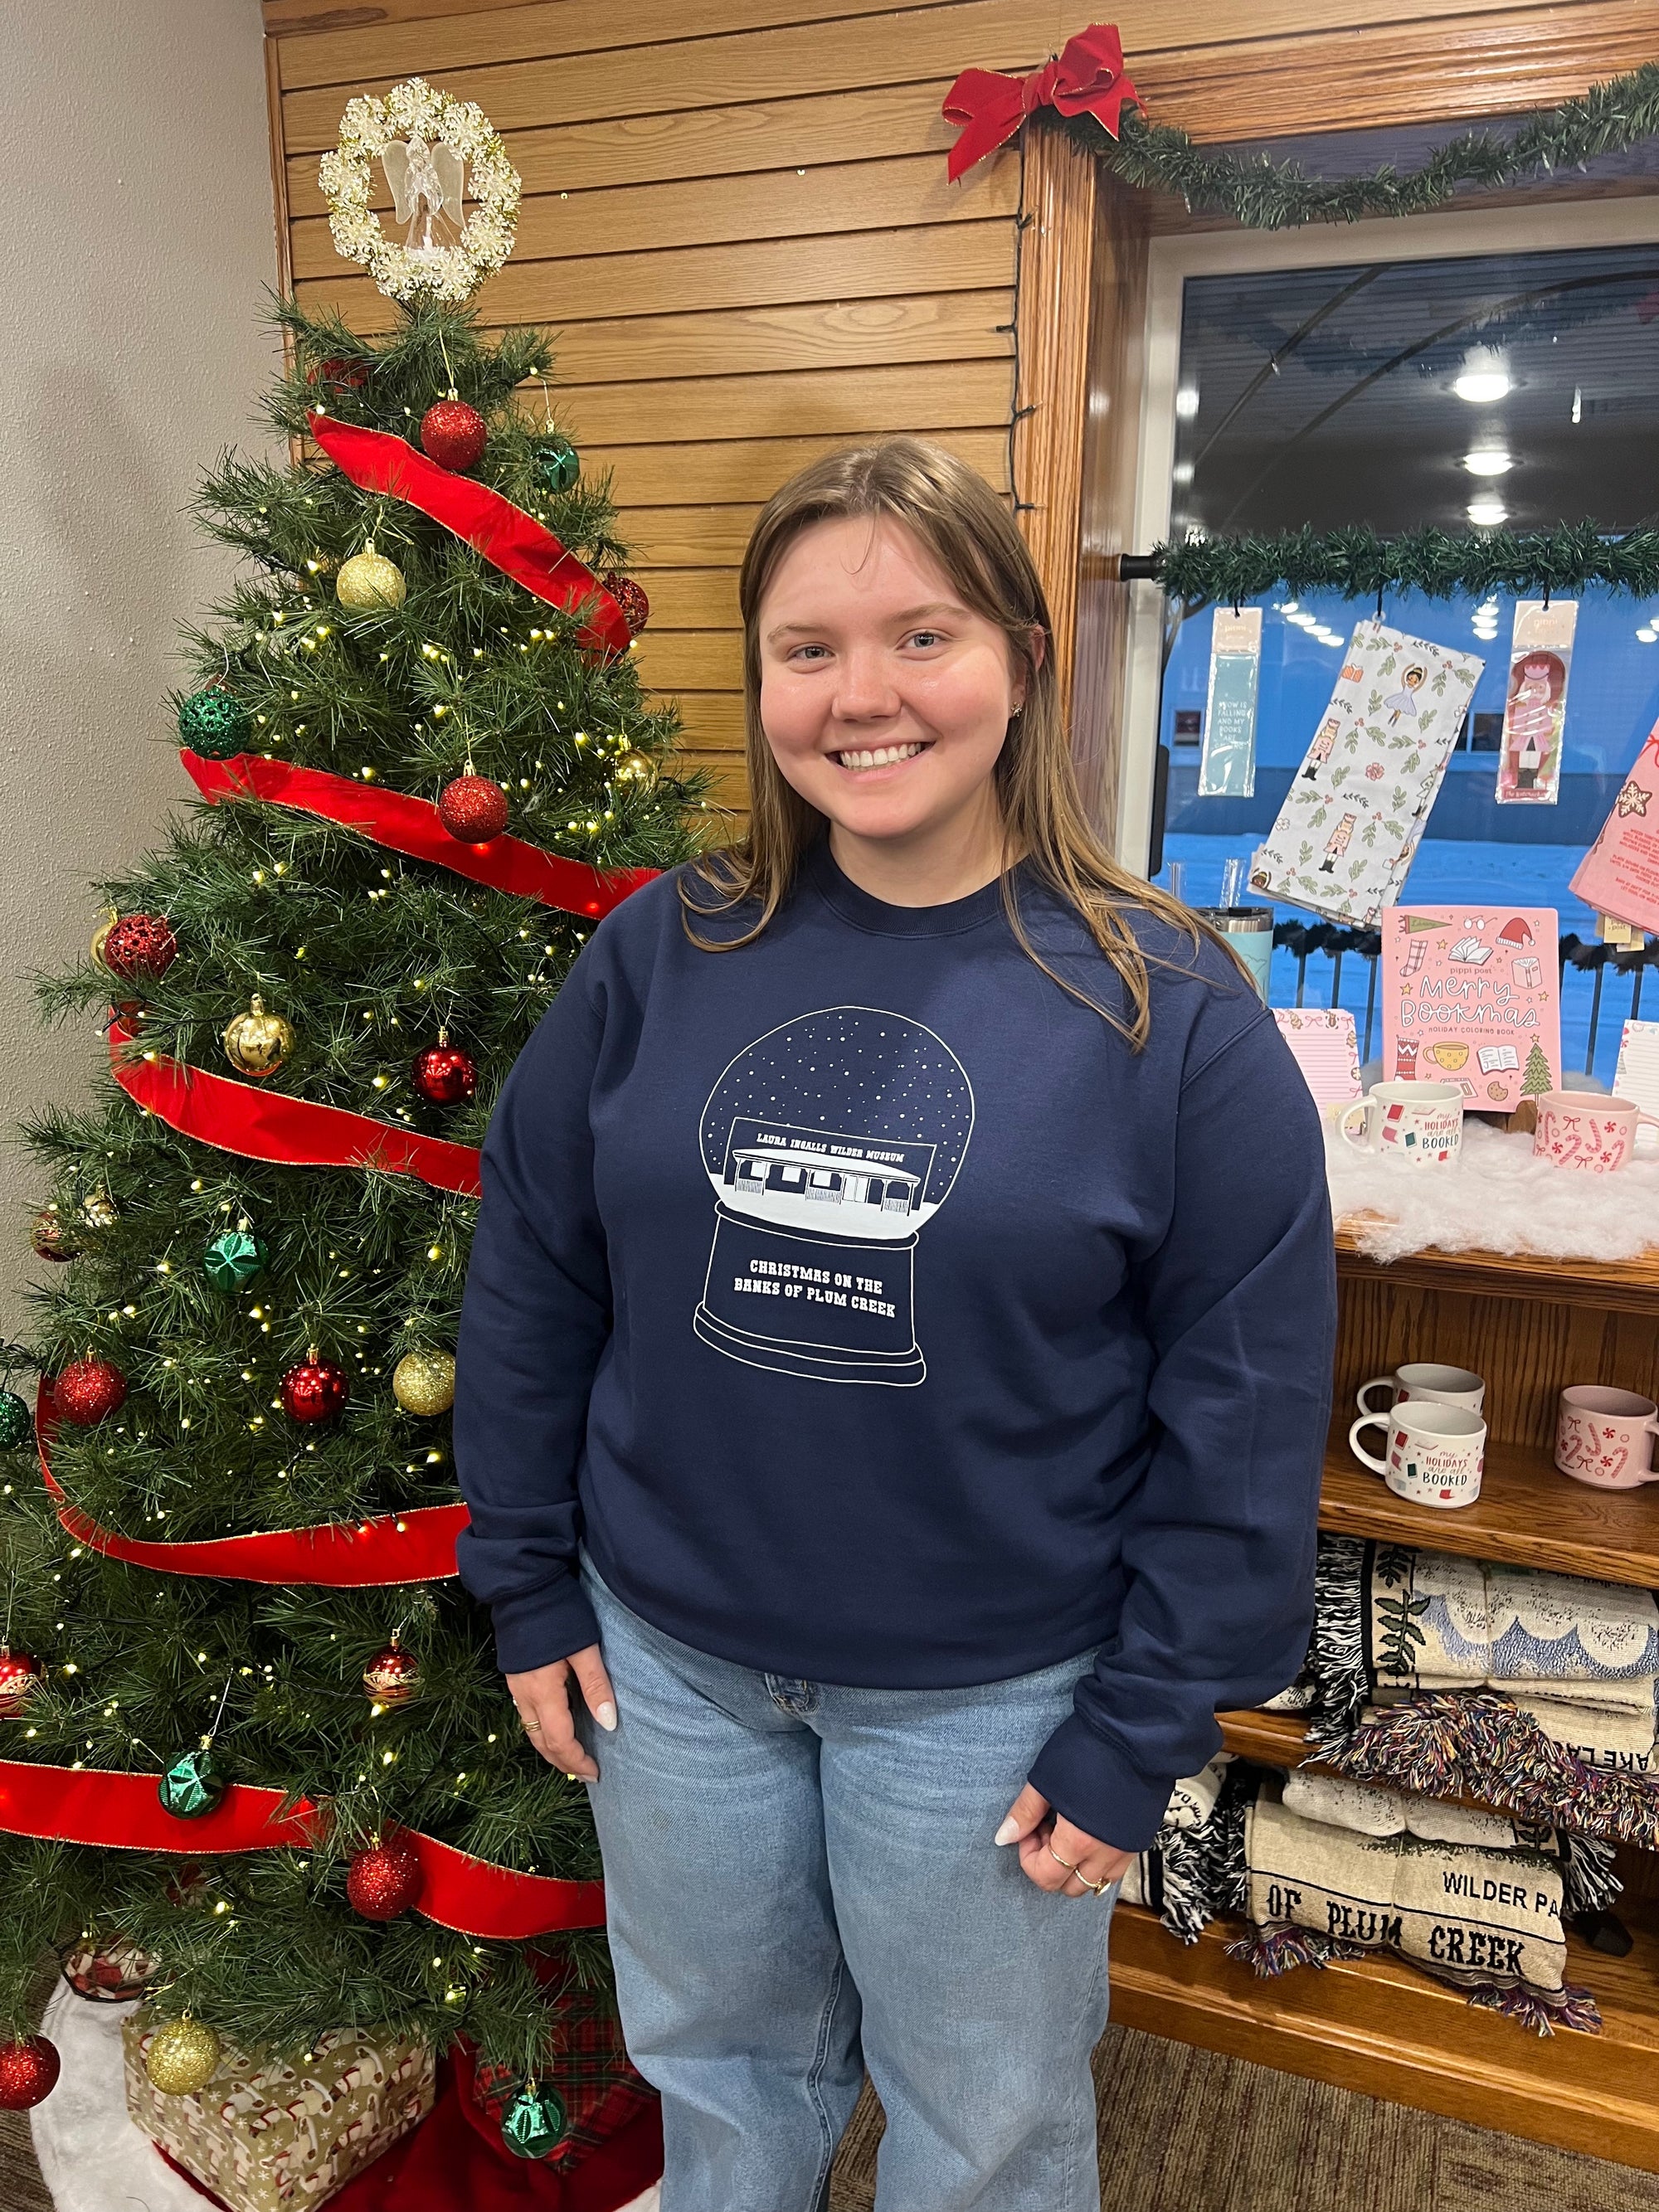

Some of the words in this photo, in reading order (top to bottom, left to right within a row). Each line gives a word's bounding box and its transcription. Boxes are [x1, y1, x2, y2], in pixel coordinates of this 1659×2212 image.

[1419, 975, 1520, 1006] Merry
[1400, 999, 1540, 1028] Bookmas
[1424, 1118, 1458, 1130] HOLIDAYS
[757, 1133, 787, 1146] LAURA
[790, 1139, 827, 1153] INGALLS
[830, 1145, 863, 1158] WILDER
[865, 1150, 905, 1163] MUSEUM
[1422, 1134, 1459, 1149] BOOKED
[750, 1259, 830, 1284] CHRISTMAS
[834, 1273, 852, 1288] ON
[856, 1277, 883, 1295] THE
[733, 1277, 781, 1296] BANKS
[784, 1284, 803, 1298] OF
[806, 1286, 847, 1307] PLUM
[851, 1296, 896, 1318] CREEK
[1426, 1456, 1467, 1467] HOLIDAYS
[1423, 1471, 1467, 1486] BOOKED
[1443, 1871, 1527, 1910] WILDER
[1266, 1884, 1301, 1919] OF
[1326, 1899, 1403, 1947] PLUM
[1428, 1924, 1526, 1976] CREEK
